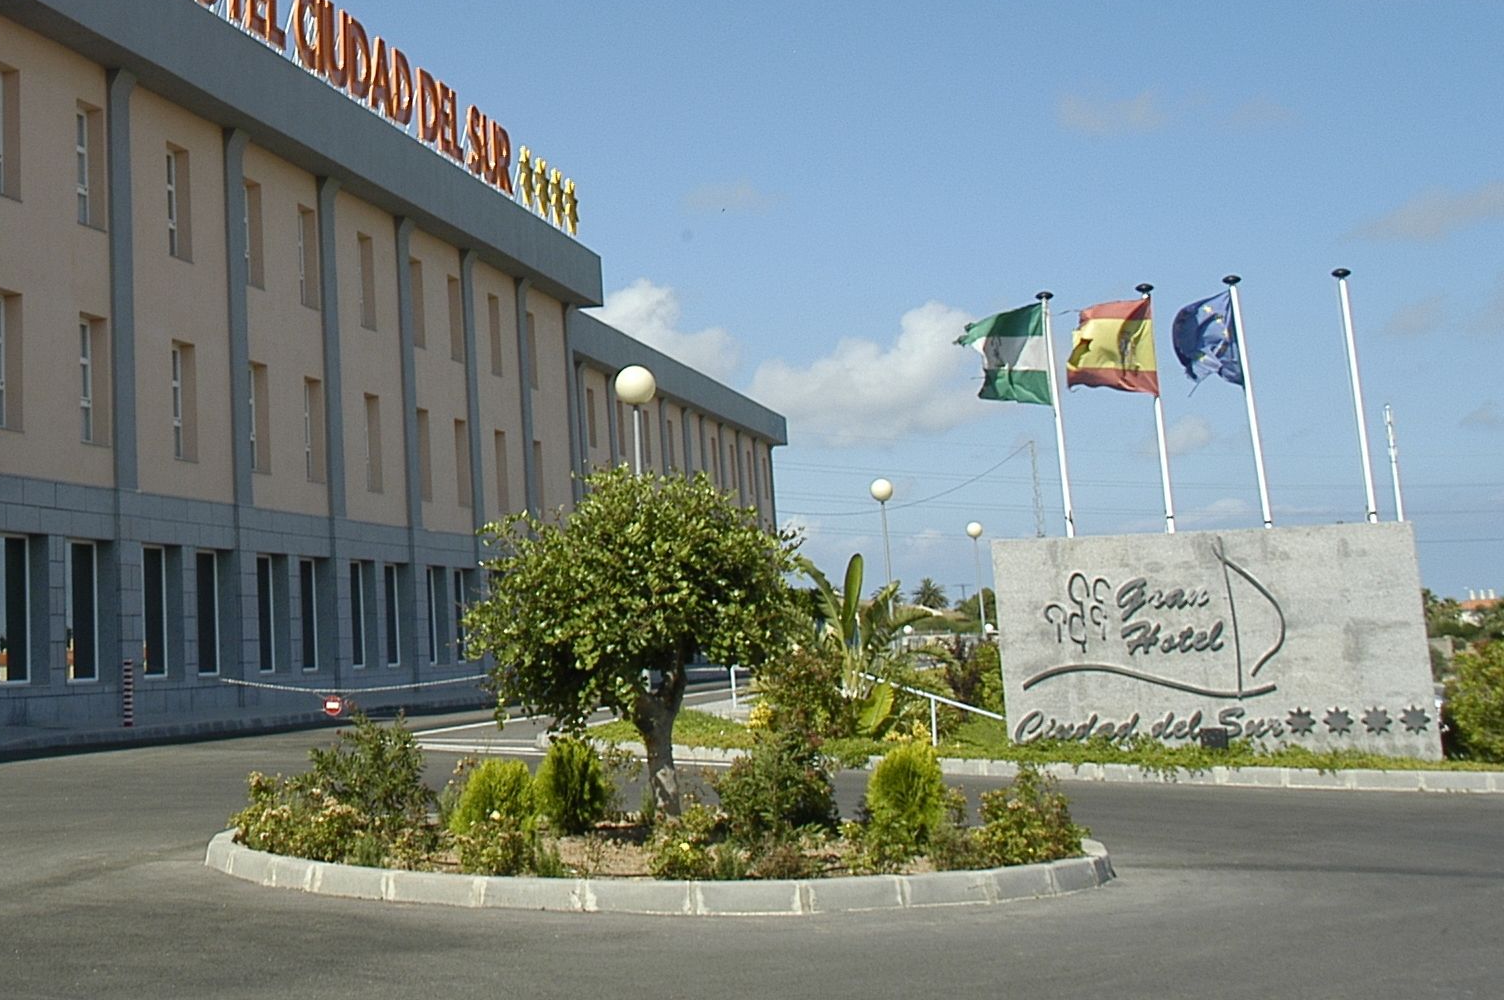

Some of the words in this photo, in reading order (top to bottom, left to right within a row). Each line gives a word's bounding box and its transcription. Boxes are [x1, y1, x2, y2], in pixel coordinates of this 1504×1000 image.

[416, 66, 464, 163] DEL
[466, 104, 513, 195] SUR
[1115, 577, 1210, 622] Gran
[1120, 620, 1224, 656] Hotel
[1014, 710, 1139, 745] Ciudad
[1151, 711, 1202, 741] del
[1219, 707, 1284, 738] Sur
